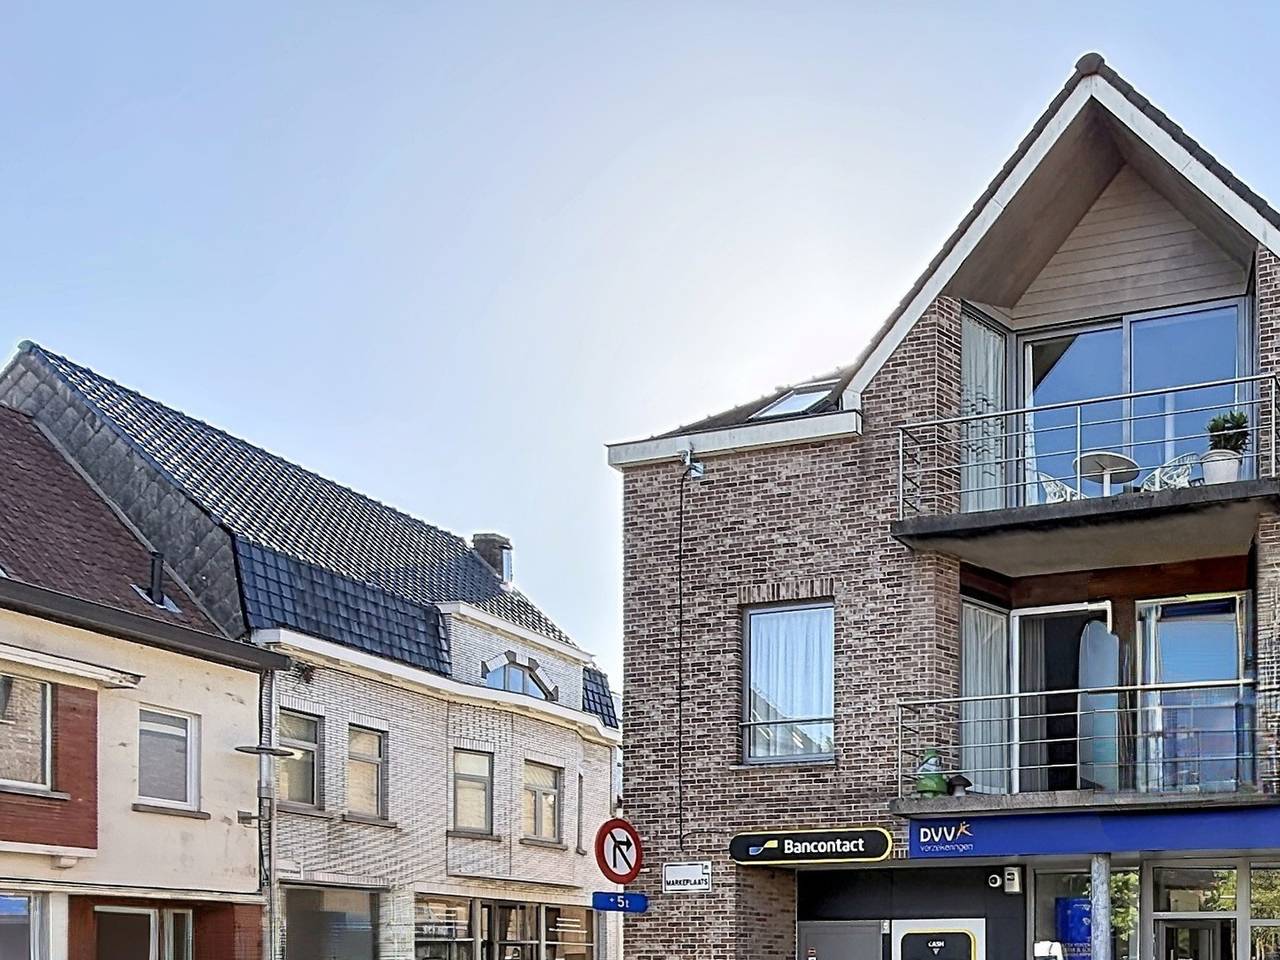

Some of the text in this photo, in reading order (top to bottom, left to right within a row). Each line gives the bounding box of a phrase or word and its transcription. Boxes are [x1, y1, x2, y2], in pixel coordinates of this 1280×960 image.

[920, 826, 955, 842] DVV
[784, 838, 865, 854] Bancontact
[927, 940, 945, 948] CASH
